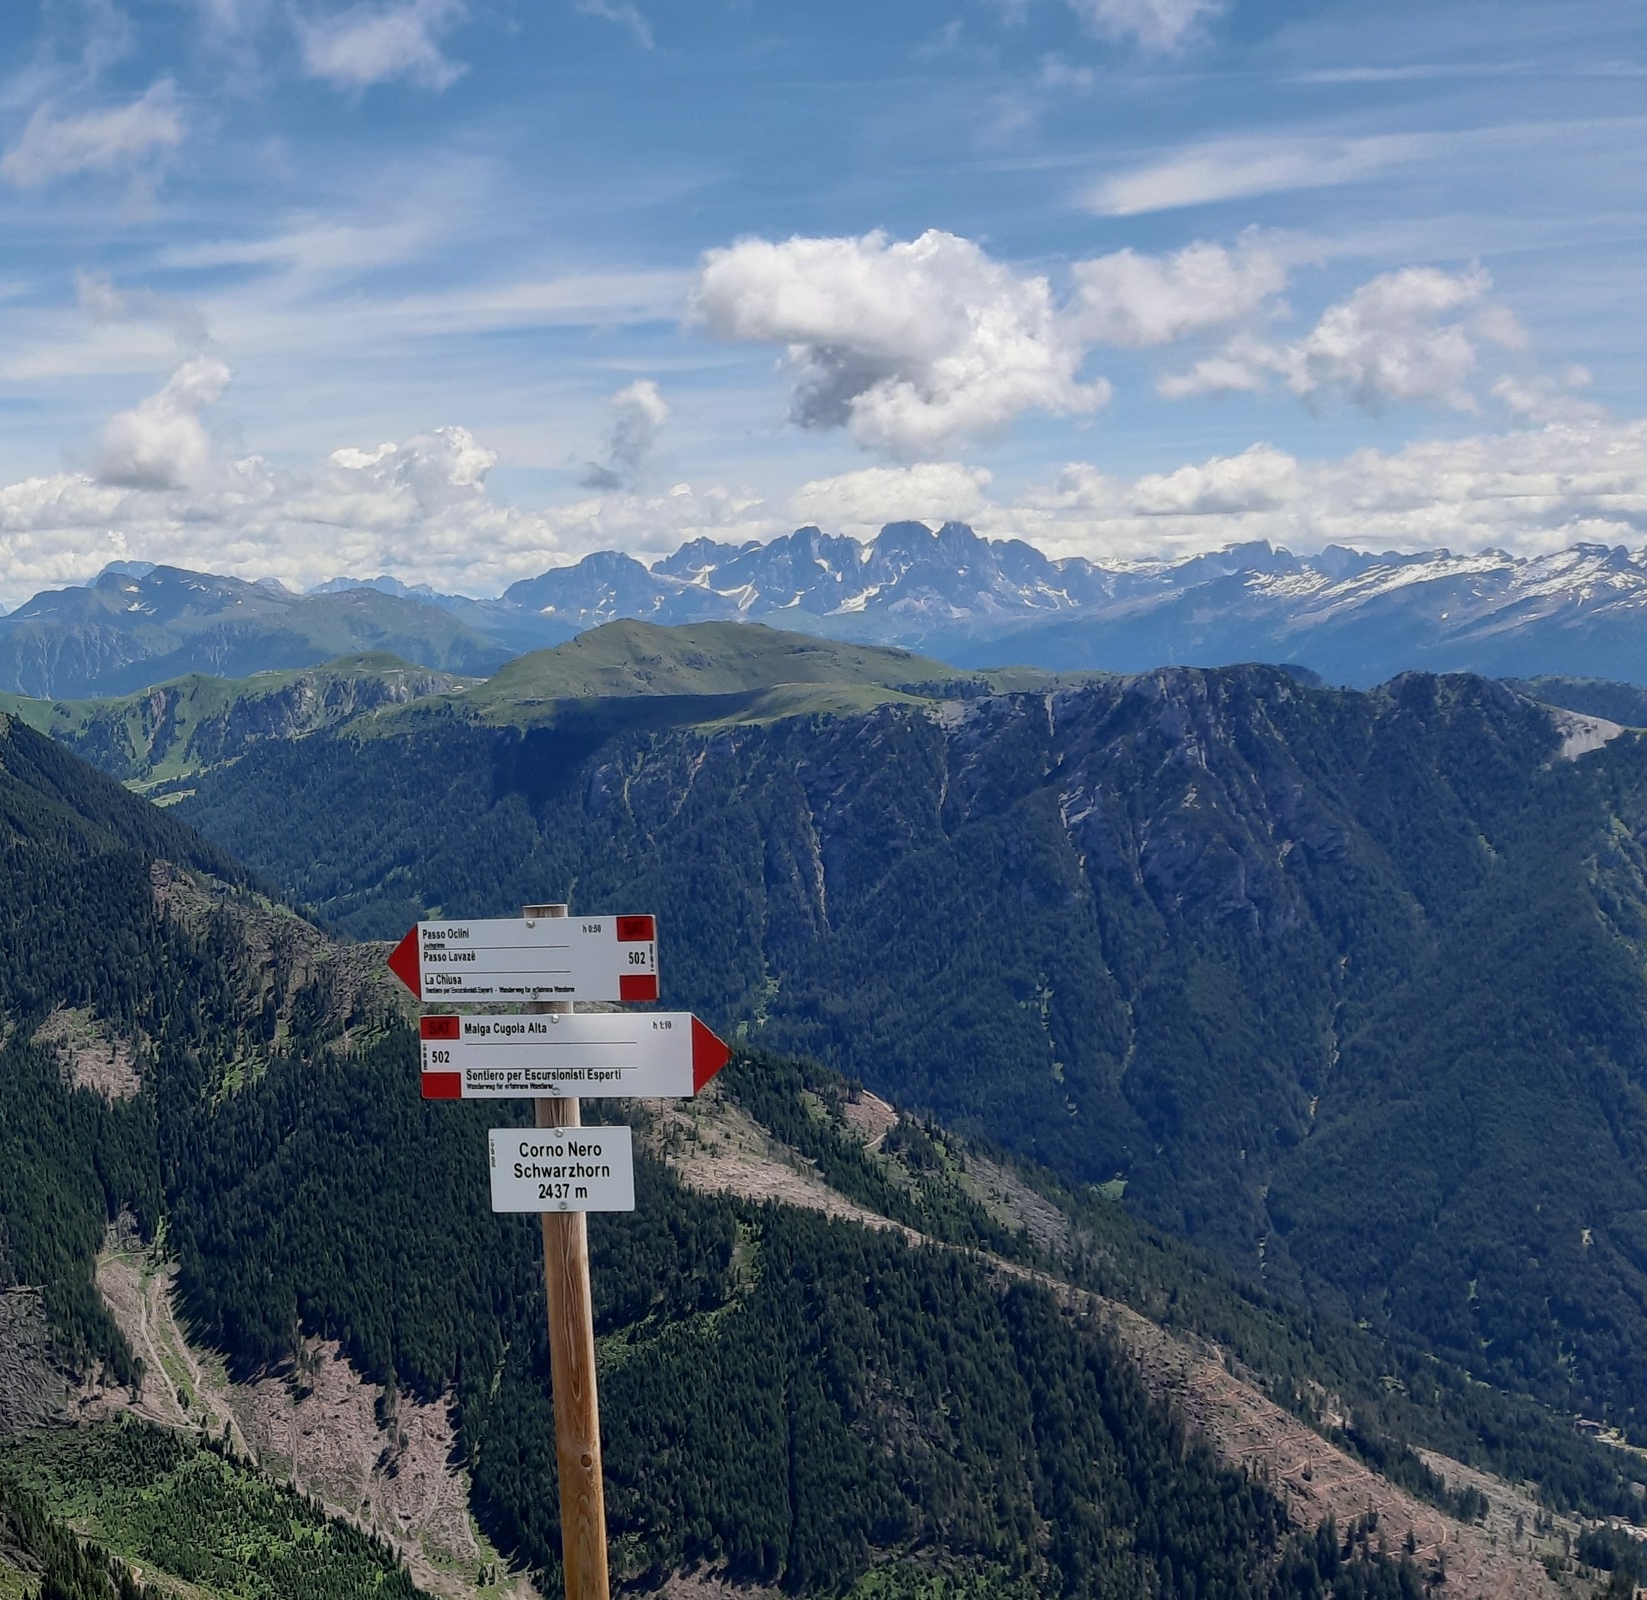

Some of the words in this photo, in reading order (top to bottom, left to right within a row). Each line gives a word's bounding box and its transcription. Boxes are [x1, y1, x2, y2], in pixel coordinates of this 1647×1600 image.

[422, 929, 445, 939] Passo
[447, 928, 470, 939] Oclini
[582, 924, 587, 933] h
[588, 924, 602, 933] 0:50
[423, 951, 446, 962] Passo
[628, 951, 646, 964] 502
[425, 974, 434, 985] La
[436, 974, 462, 985] Chiusa
[428, 1021, 450, 1035] SAT
[465, 1022, 491, 1036] Malga
[493, 1022, 525, 1036] Cugola
[528, 1022, 547, 1033] Alta
[652, 1021, 657, 1030] h
[432, 1051, 450, 1063] 502
[466, 1069, 505, 1081] Sentiero
[507, 1071, 522, 1083] per
[524, 1069, 585, 1081] Escursionisti
[587, 1069, 621, 1082] Esperti
[519, 1142, 564, 1158] Corno
[568, 1141, 602, 1157] Nero
[514, 1162, 610, 1179] Schwarzhorn
[538, 1183, 570, 1199] 2437
[575, 1186, 588, 1198] m
